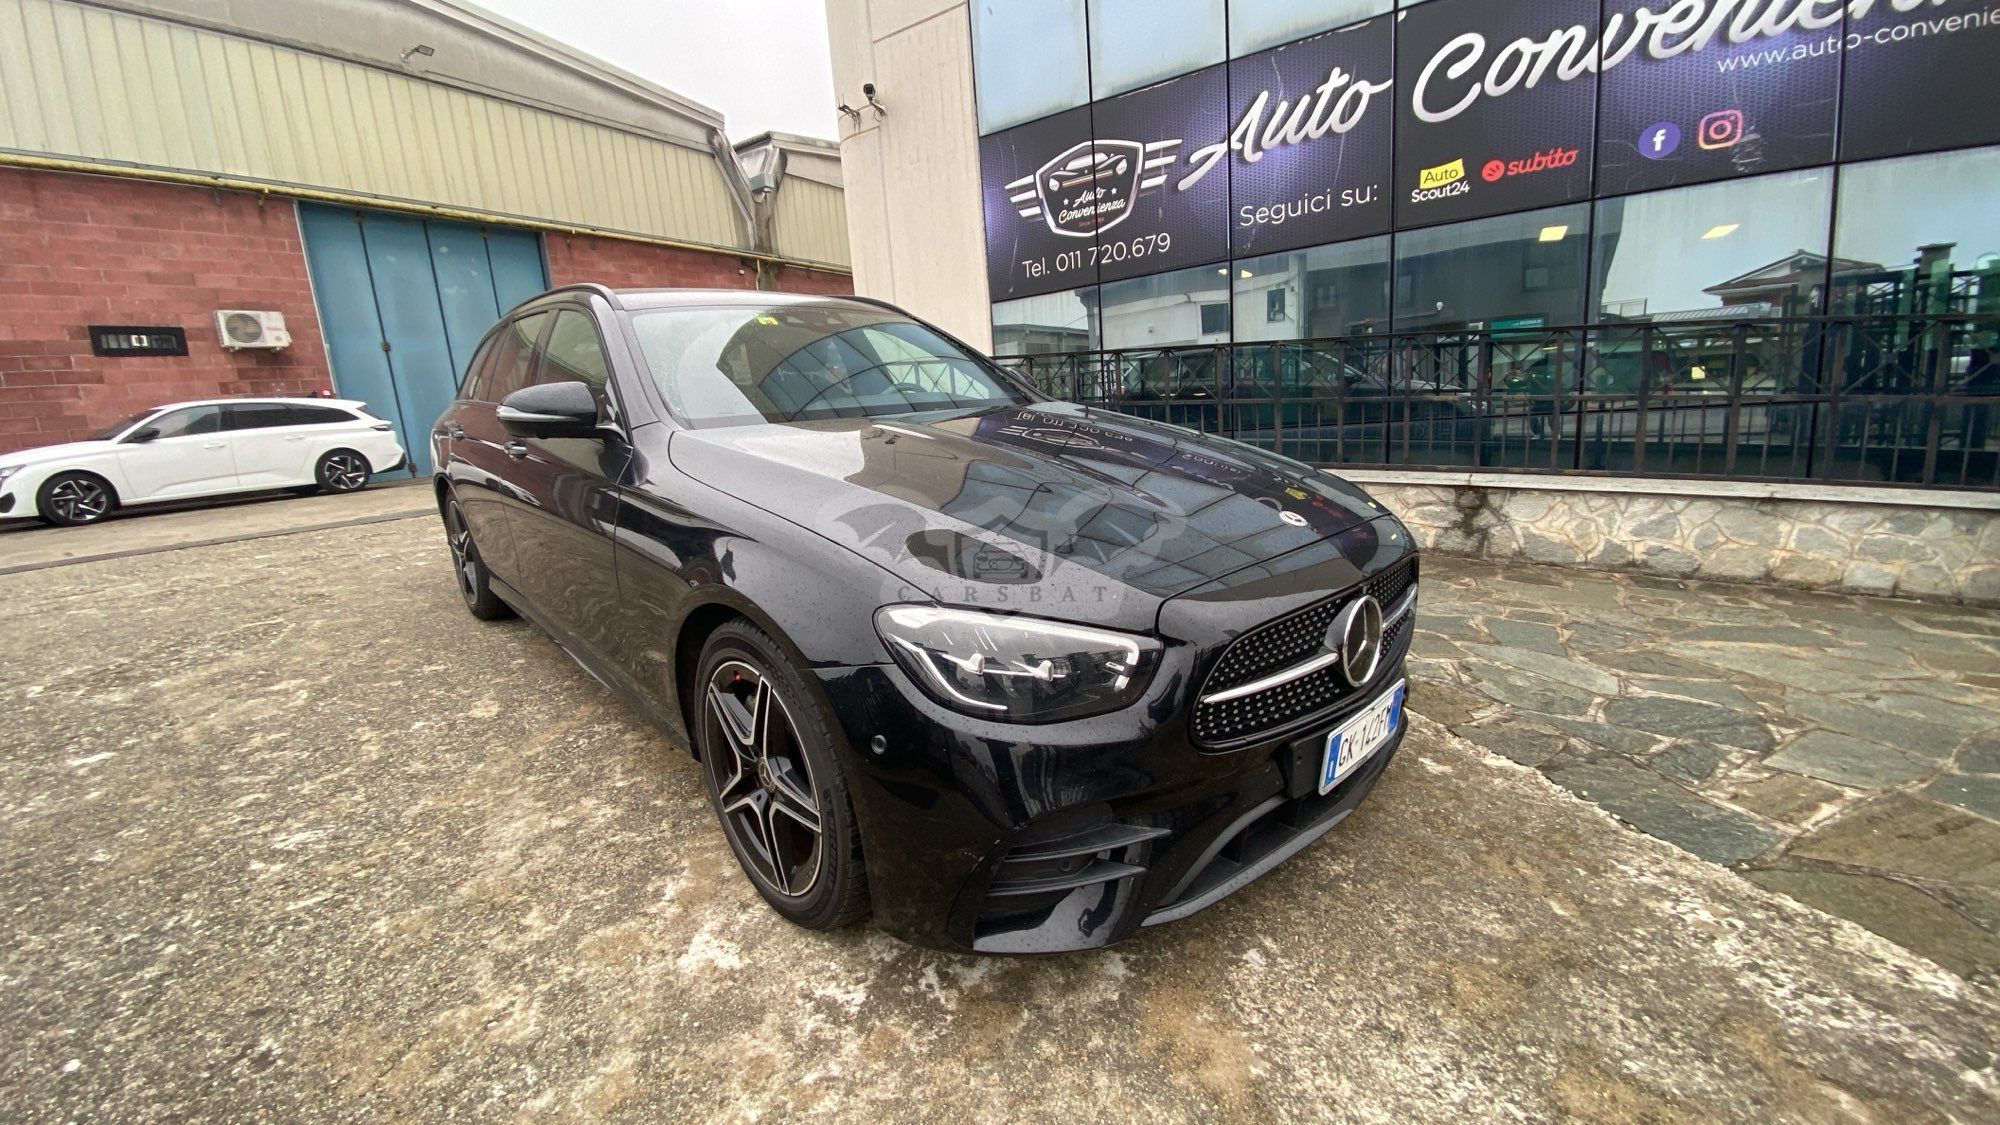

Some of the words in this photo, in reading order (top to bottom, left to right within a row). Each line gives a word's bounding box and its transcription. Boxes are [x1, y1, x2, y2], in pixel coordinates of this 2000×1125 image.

[1177, 66, 1393, 191] Auto
[1423, 168, 1459, 184] Auto
[1506, 147, 1579, 176] subito
[1240, 188, 1331, 226] Seguici
[1341, 184, 1378, 207] su:
[1411, 180, 1470, 203] Scout24
[1021, 257, 1050, 279] Tel.
[1056, 250, 1081, 272] 011
[1088, 232, 1171, 266] 720.679
